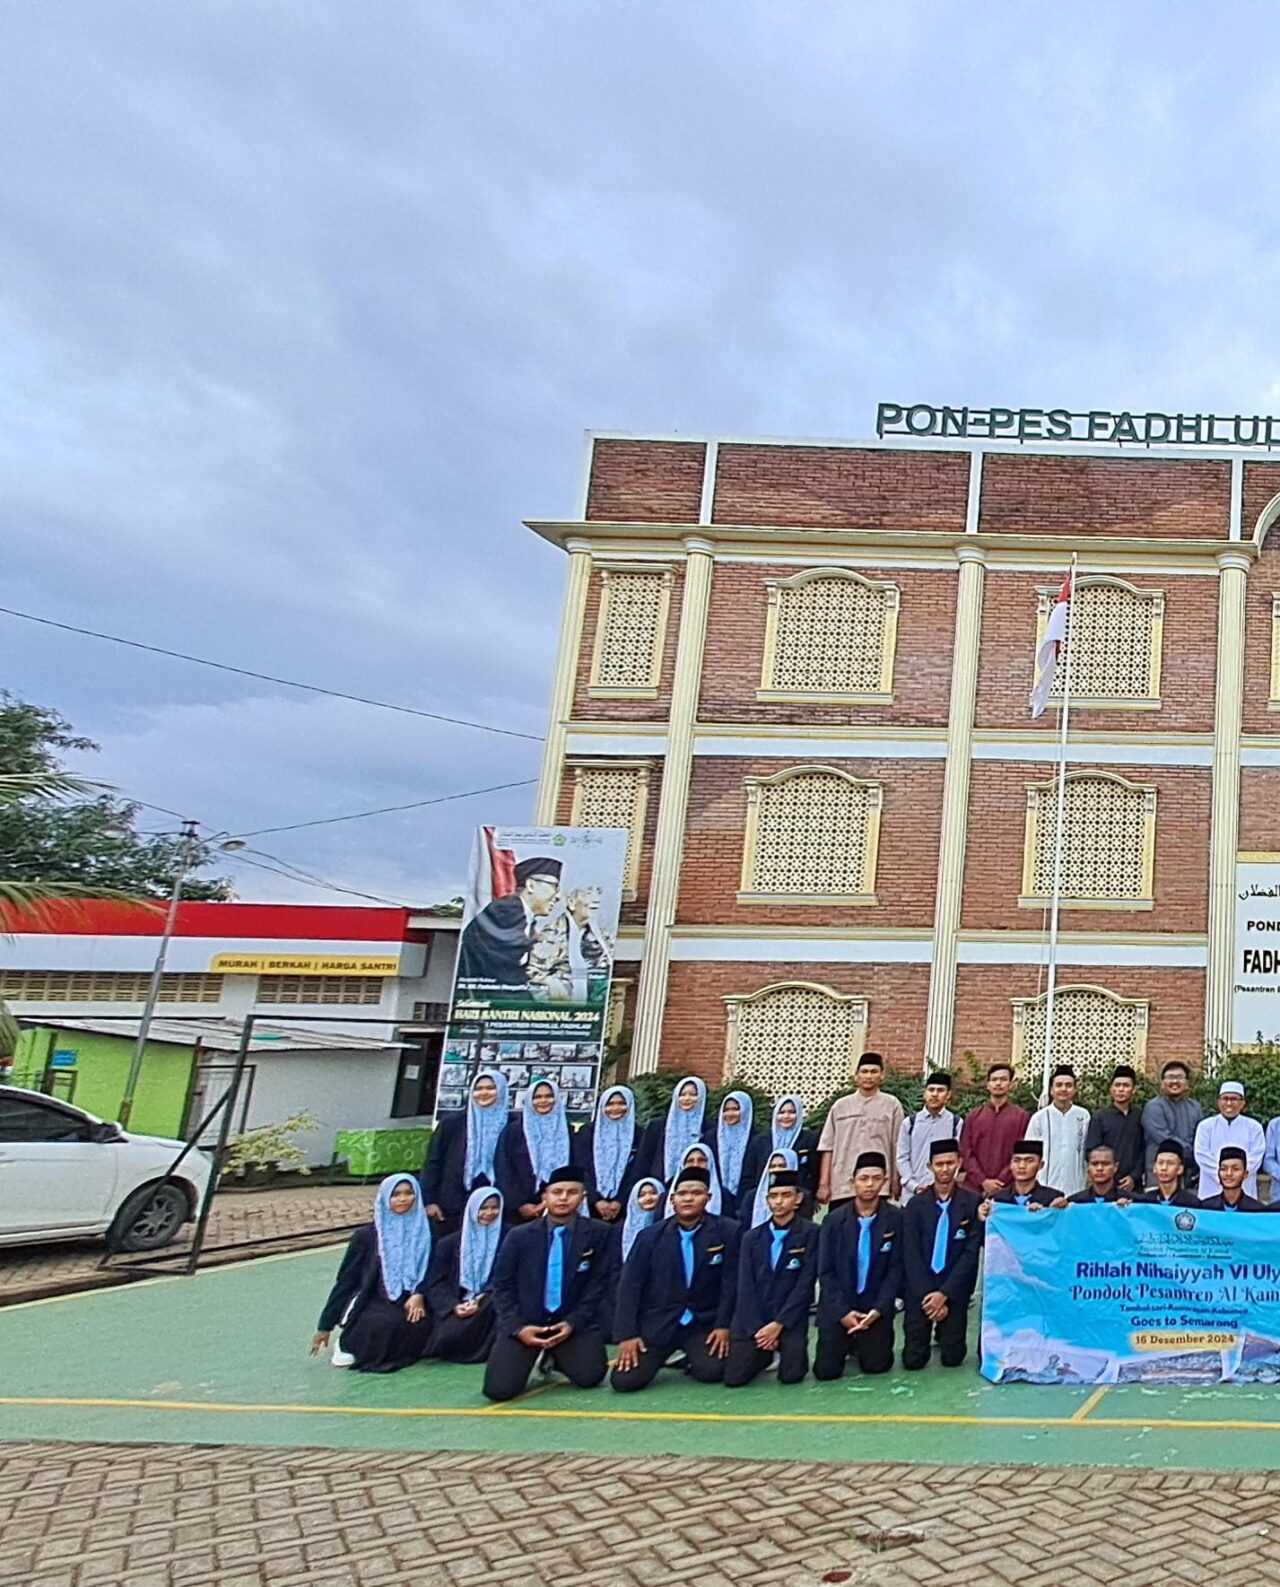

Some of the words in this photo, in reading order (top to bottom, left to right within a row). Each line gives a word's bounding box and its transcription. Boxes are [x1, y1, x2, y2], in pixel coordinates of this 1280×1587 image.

[876, 403, 1072, 440] PON-PES
[218, 960, 258, 968] MURAH
[268, 961, 311, 970] BERKAH
[321, 962, 357, 970] HARGA
[360, 963, 397, 971] SANTRI
[1076, 1261, 1132, 1278] Rihlah
[1136, 1261, 1224, 1284] Nihaiyyah
[1229, 1264, 1248, 1280] VI
[1069, 1283, 1135, 1302] Pondok
[1136, 1283, 1213, 1304] Pesantren
[1218, 1286, 1237, 1302] Al
[1131, 1315, 1162, 1327] Goes
[1165, 1316, 1177, 1326] to
[1180, 1315, 1239, 1329] Semarang
[1136, 1335, 1147, 1345] 16
[1150, 1333, 1205, 1345] Desember
[1207, 1333, 1235, 1344] 2024
